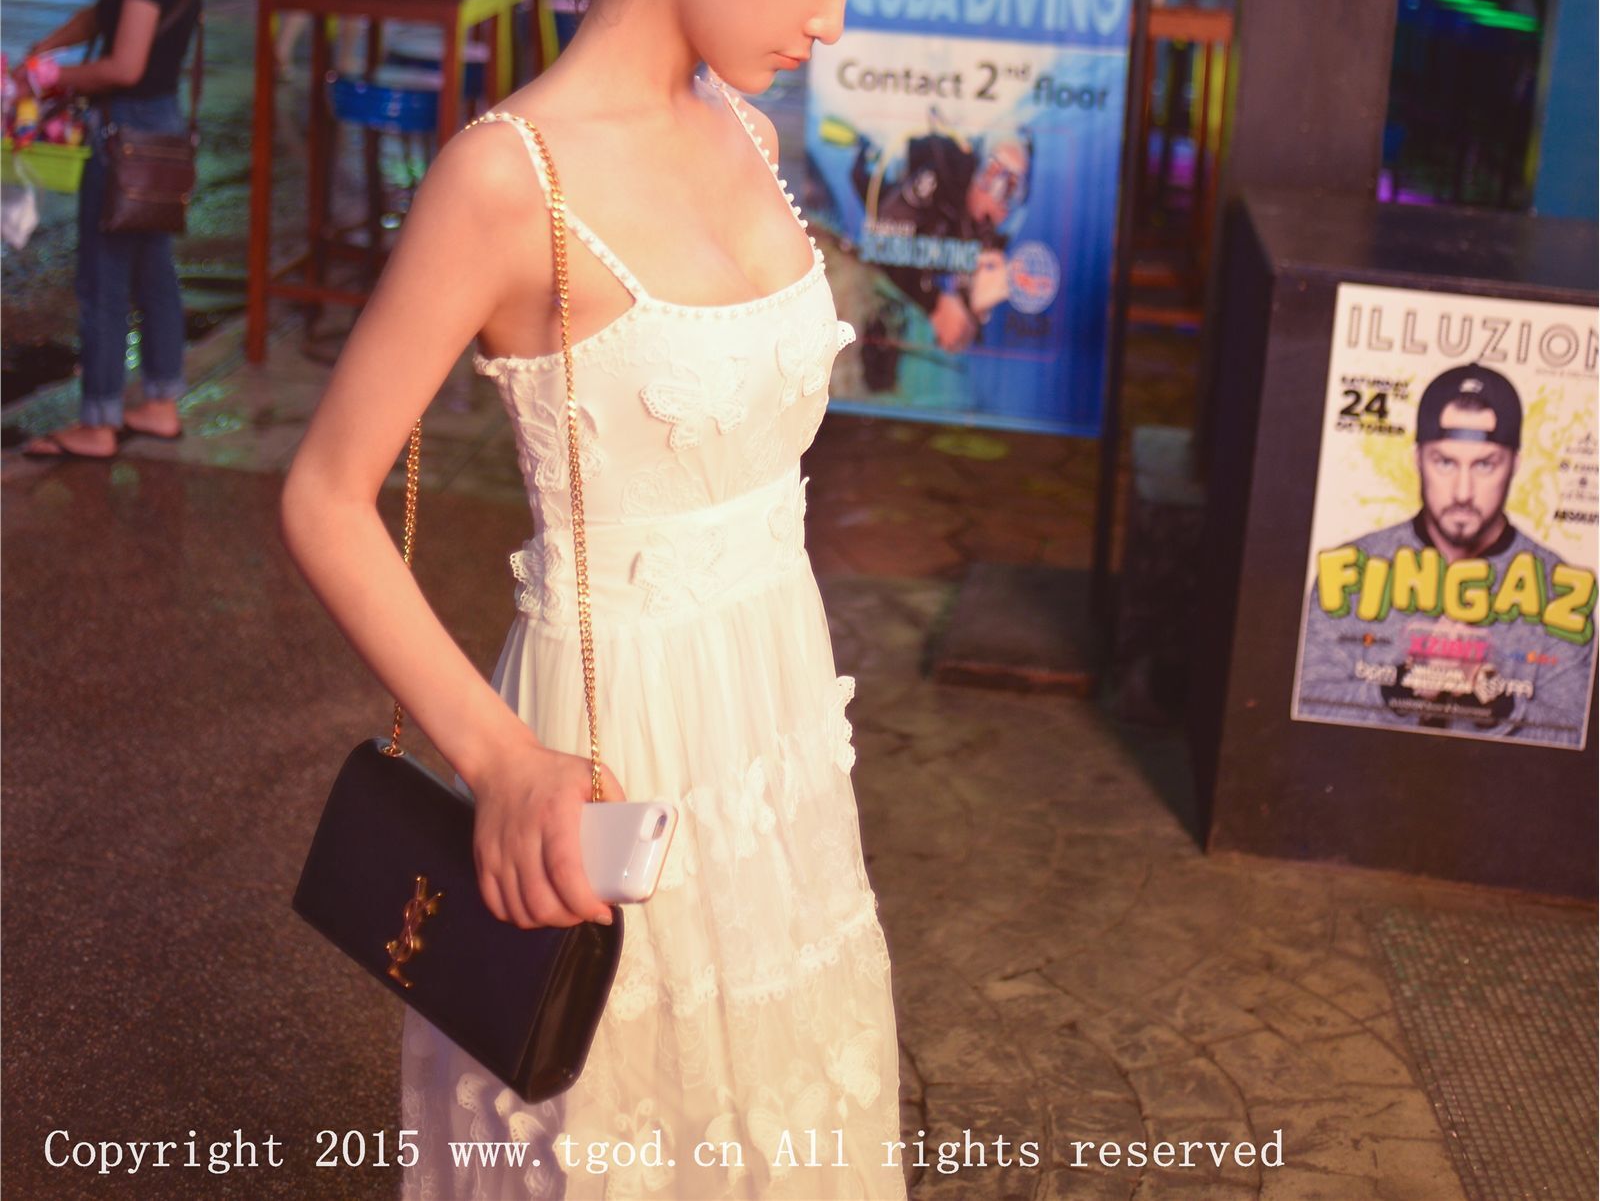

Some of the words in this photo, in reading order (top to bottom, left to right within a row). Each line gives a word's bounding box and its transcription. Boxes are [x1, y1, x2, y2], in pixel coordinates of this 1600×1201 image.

[838, 61, 963, 99] Contact
[1033, 74, 1110, 110] floor
[1339, 388, 1389, 420] 24
